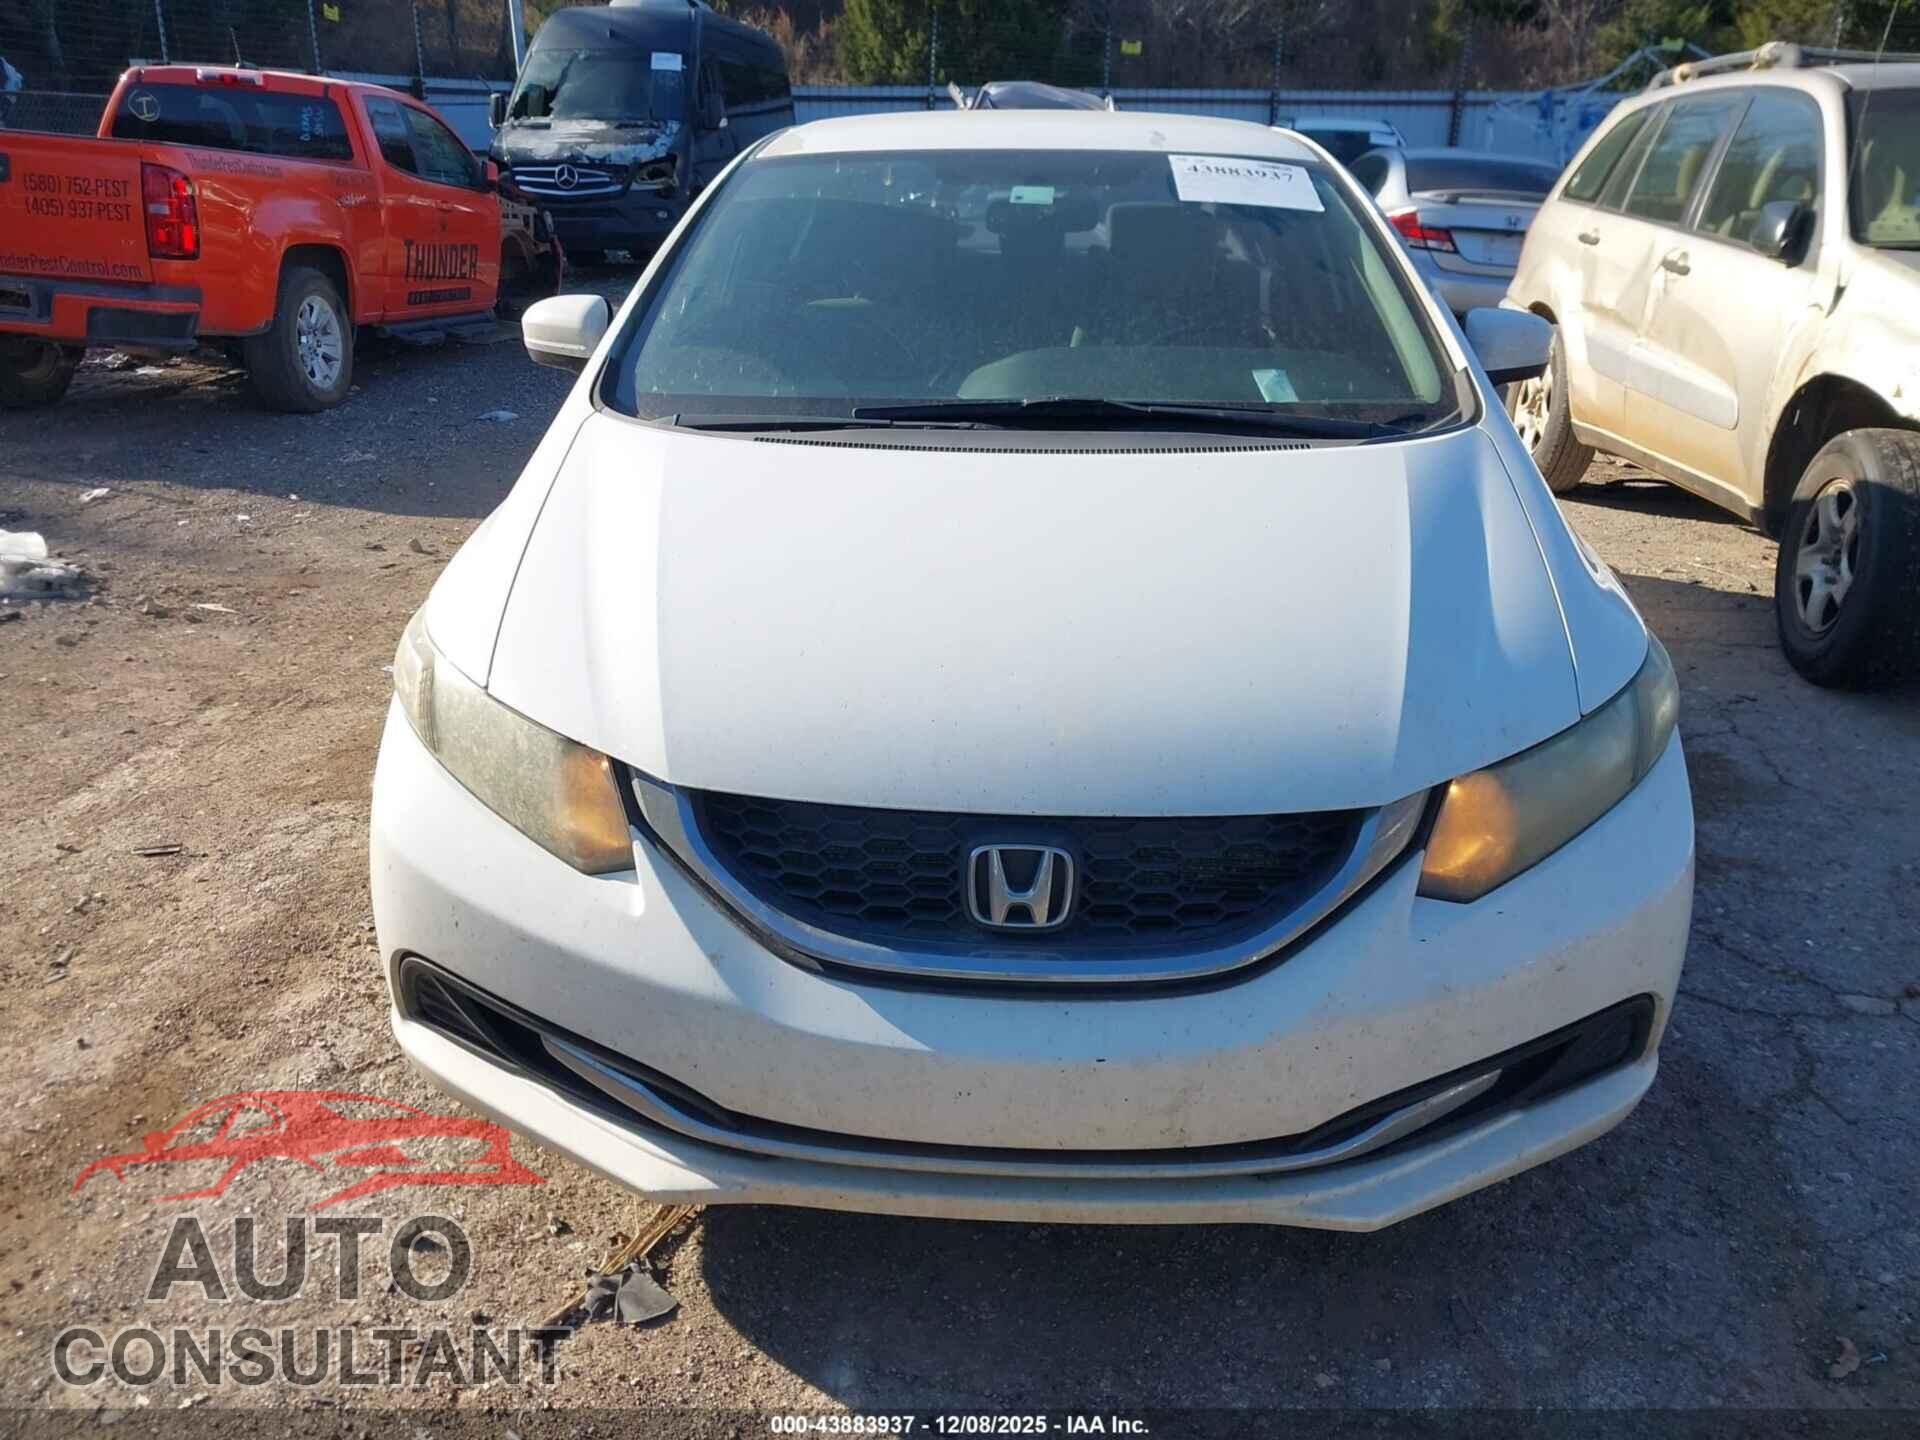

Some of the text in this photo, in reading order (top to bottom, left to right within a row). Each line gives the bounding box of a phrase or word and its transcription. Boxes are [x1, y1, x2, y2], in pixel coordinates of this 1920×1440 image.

[24, 173, 61, 193] (580)
[25, 197, 64, 216] (405)
[404, 240, 479, 282] THUNDER
